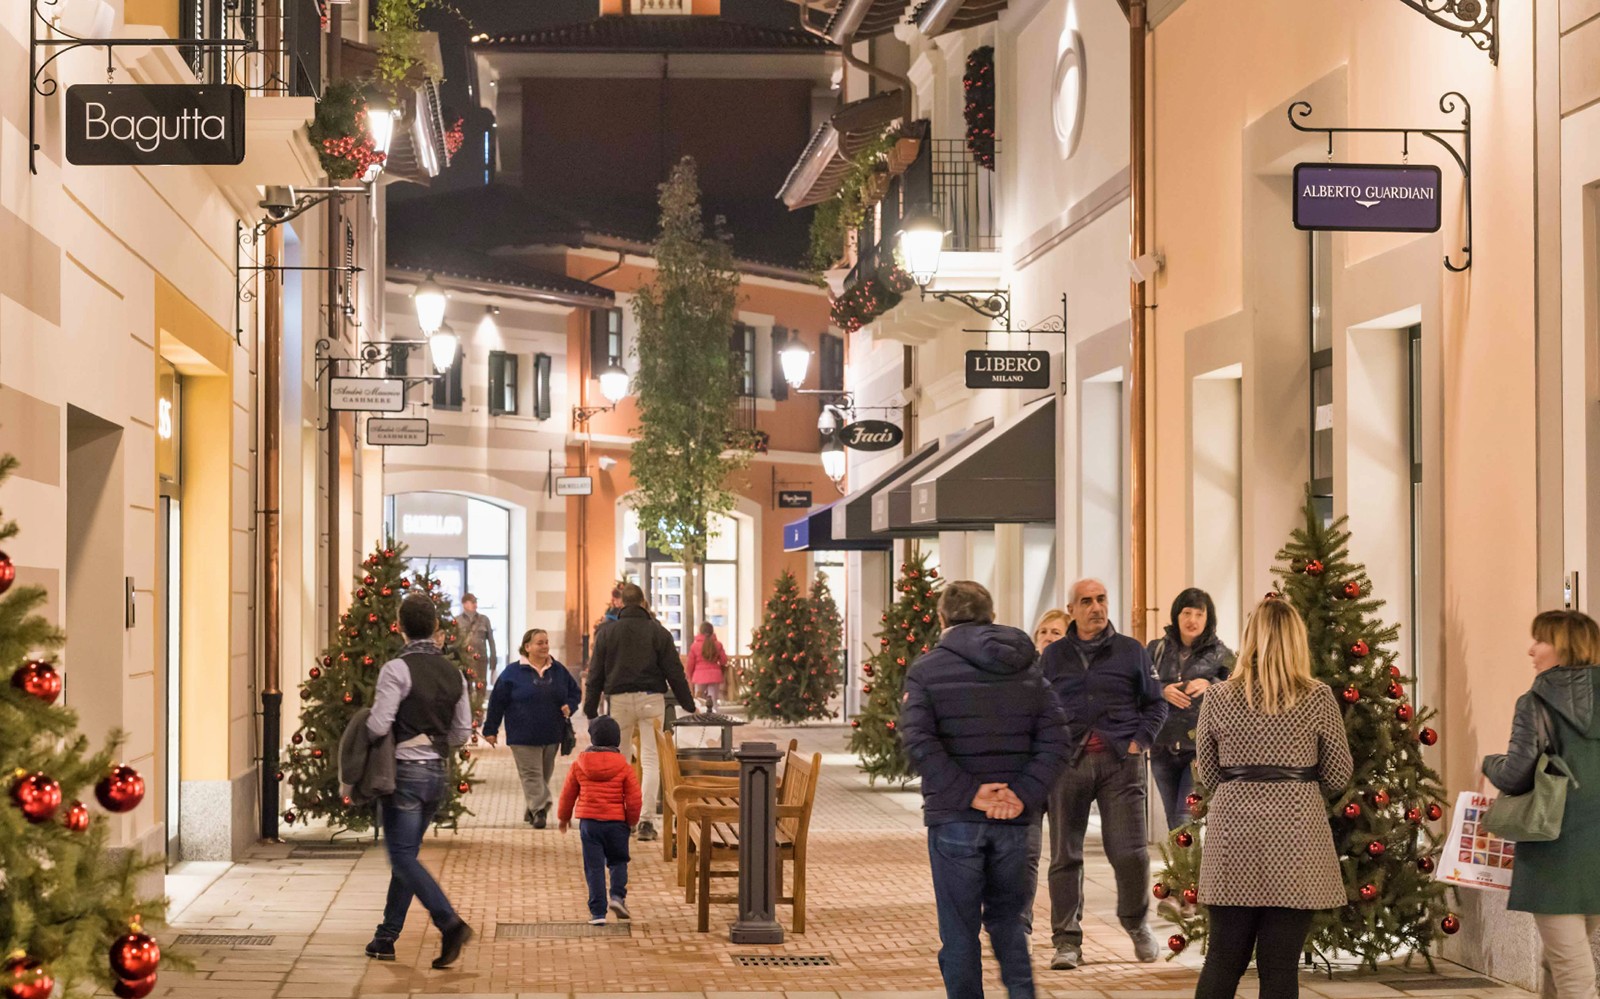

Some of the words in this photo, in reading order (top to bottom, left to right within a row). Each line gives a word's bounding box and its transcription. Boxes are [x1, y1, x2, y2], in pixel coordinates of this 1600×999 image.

[85, 102, 226, 153] Bagutta
[1302, 185, 1361, 199] ALBERTO
[1365, 186, 1434, 200] GUARDIANI
[974, 357, 1041, 372] LIBERO
[991, 375, 1024, 383] MILANO
[850, 426, 893, 445] Facis
